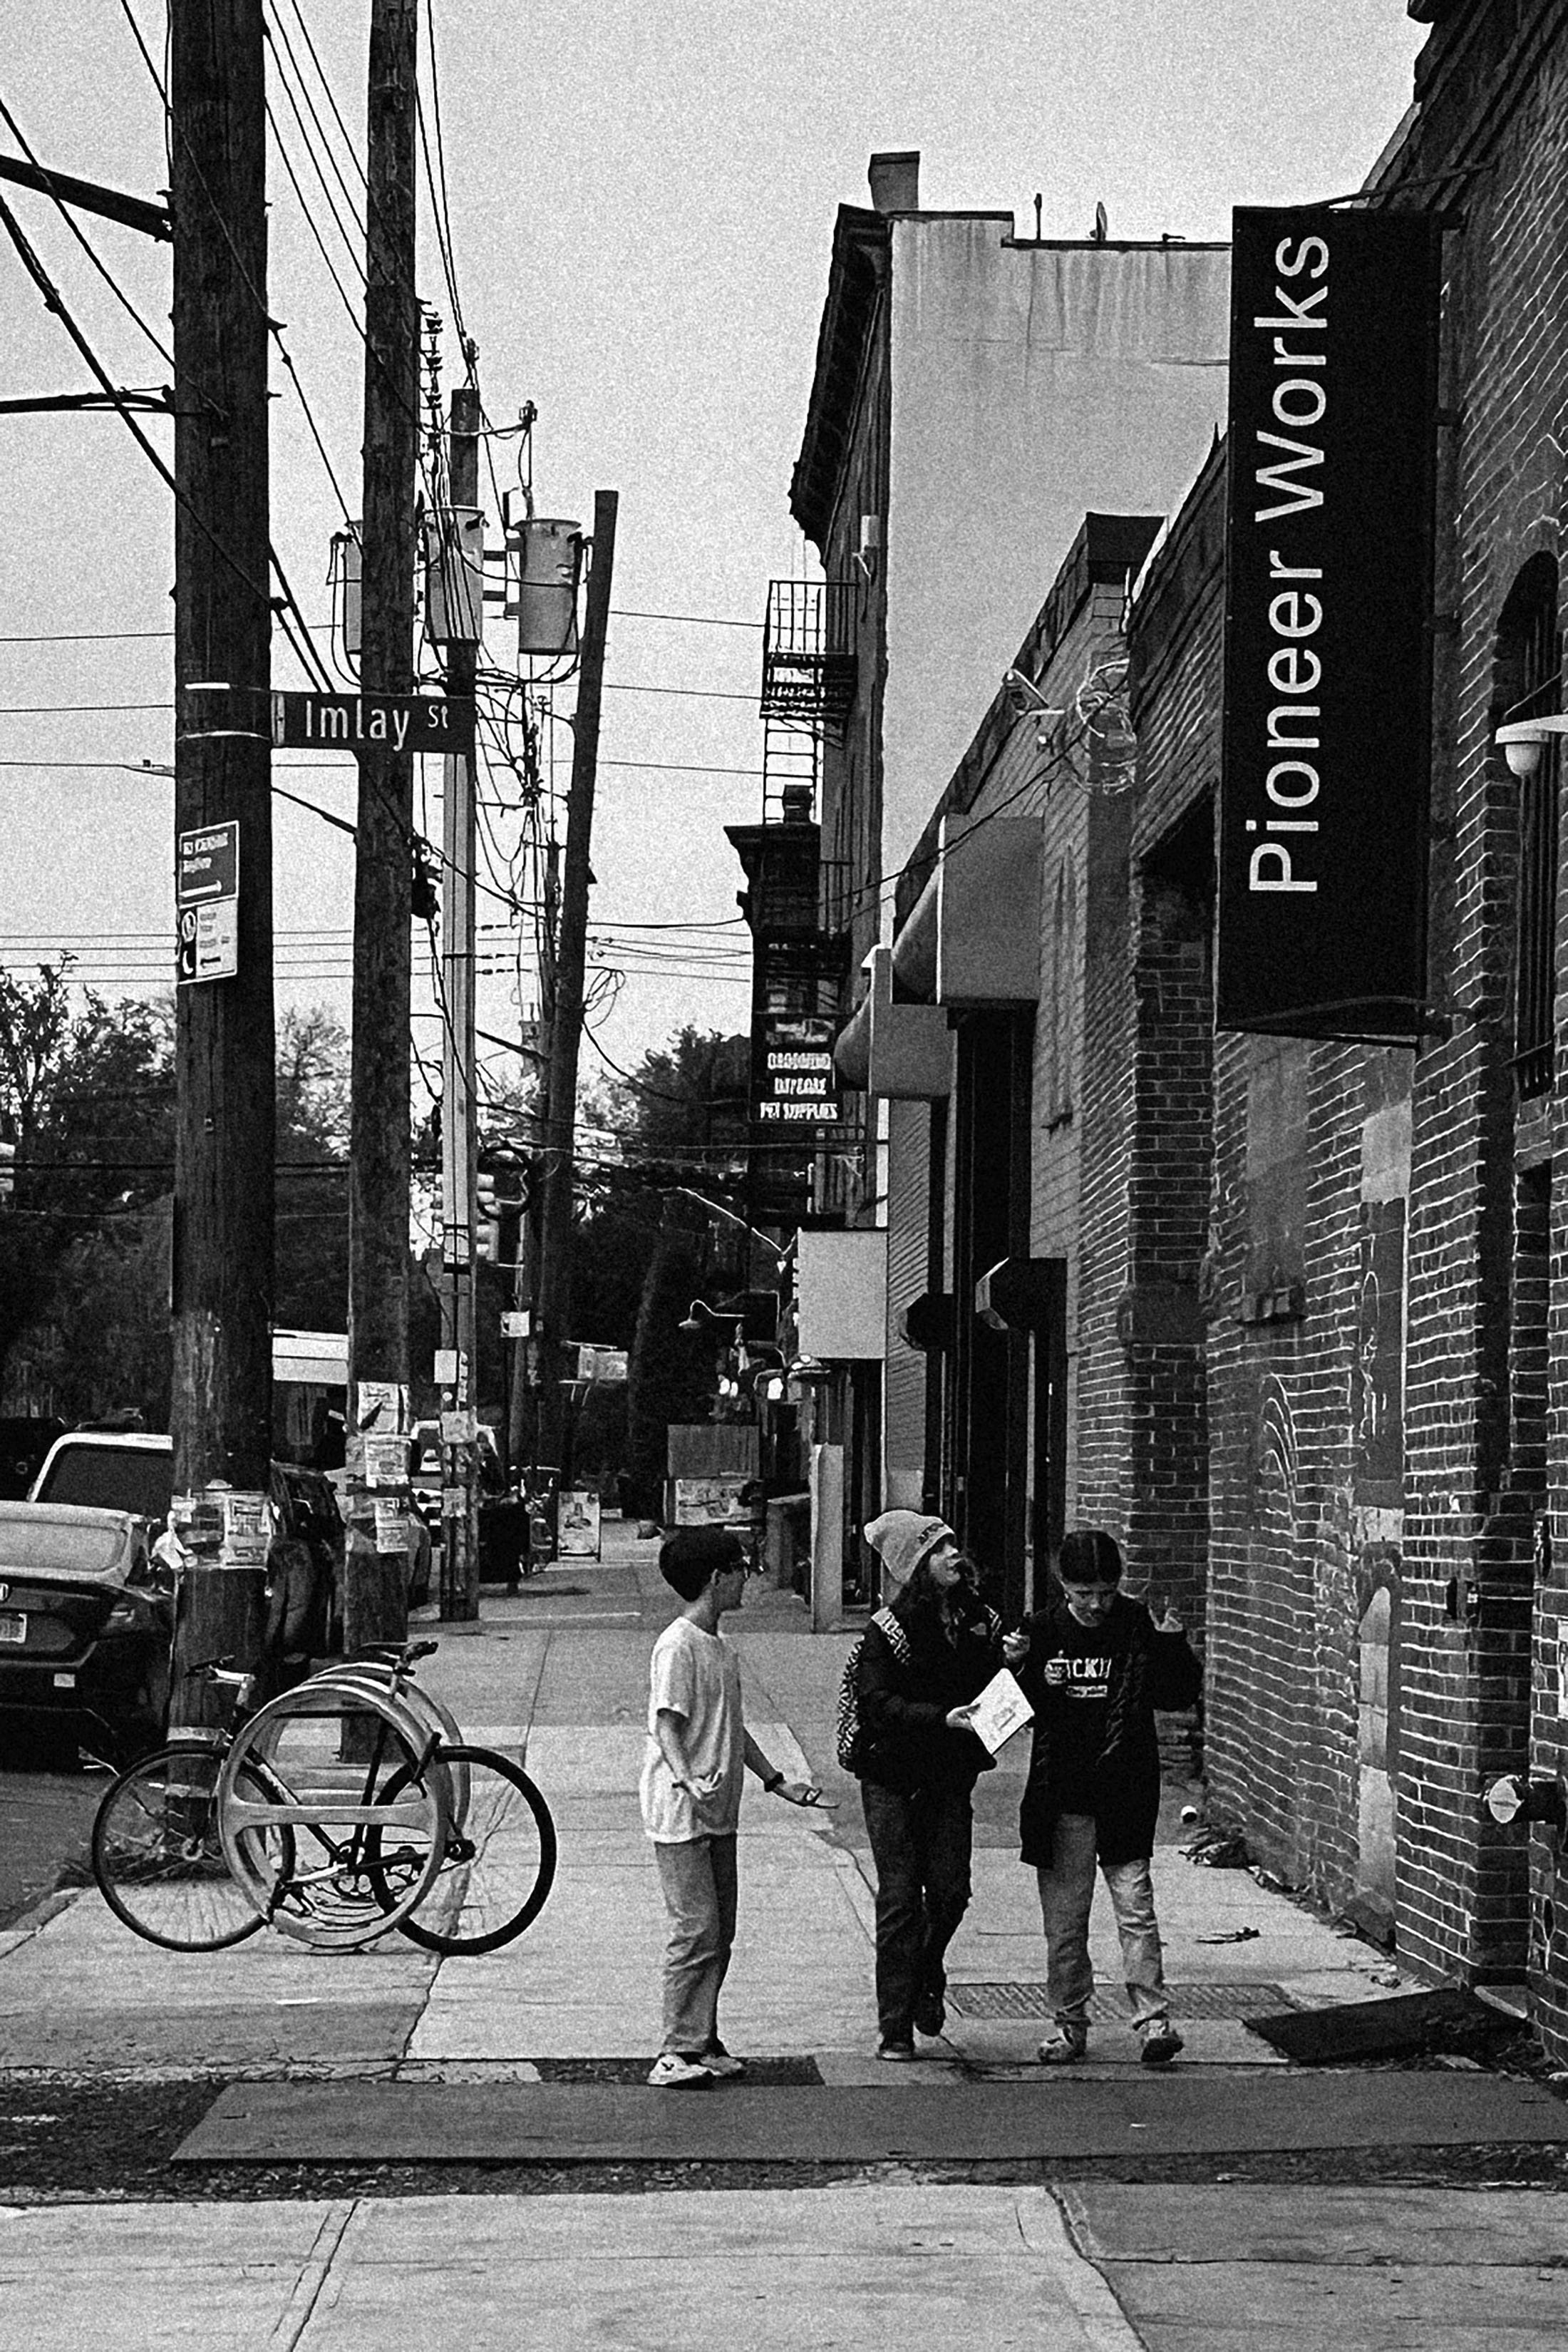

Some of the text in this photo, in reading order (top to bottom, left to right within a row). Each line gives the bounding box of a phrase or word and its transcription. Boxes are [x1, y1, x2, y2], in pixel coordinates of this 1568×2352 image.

[306, 698, 448, 751] Imlay St
[1246, 236, 1329, 893] Pioneer Works
